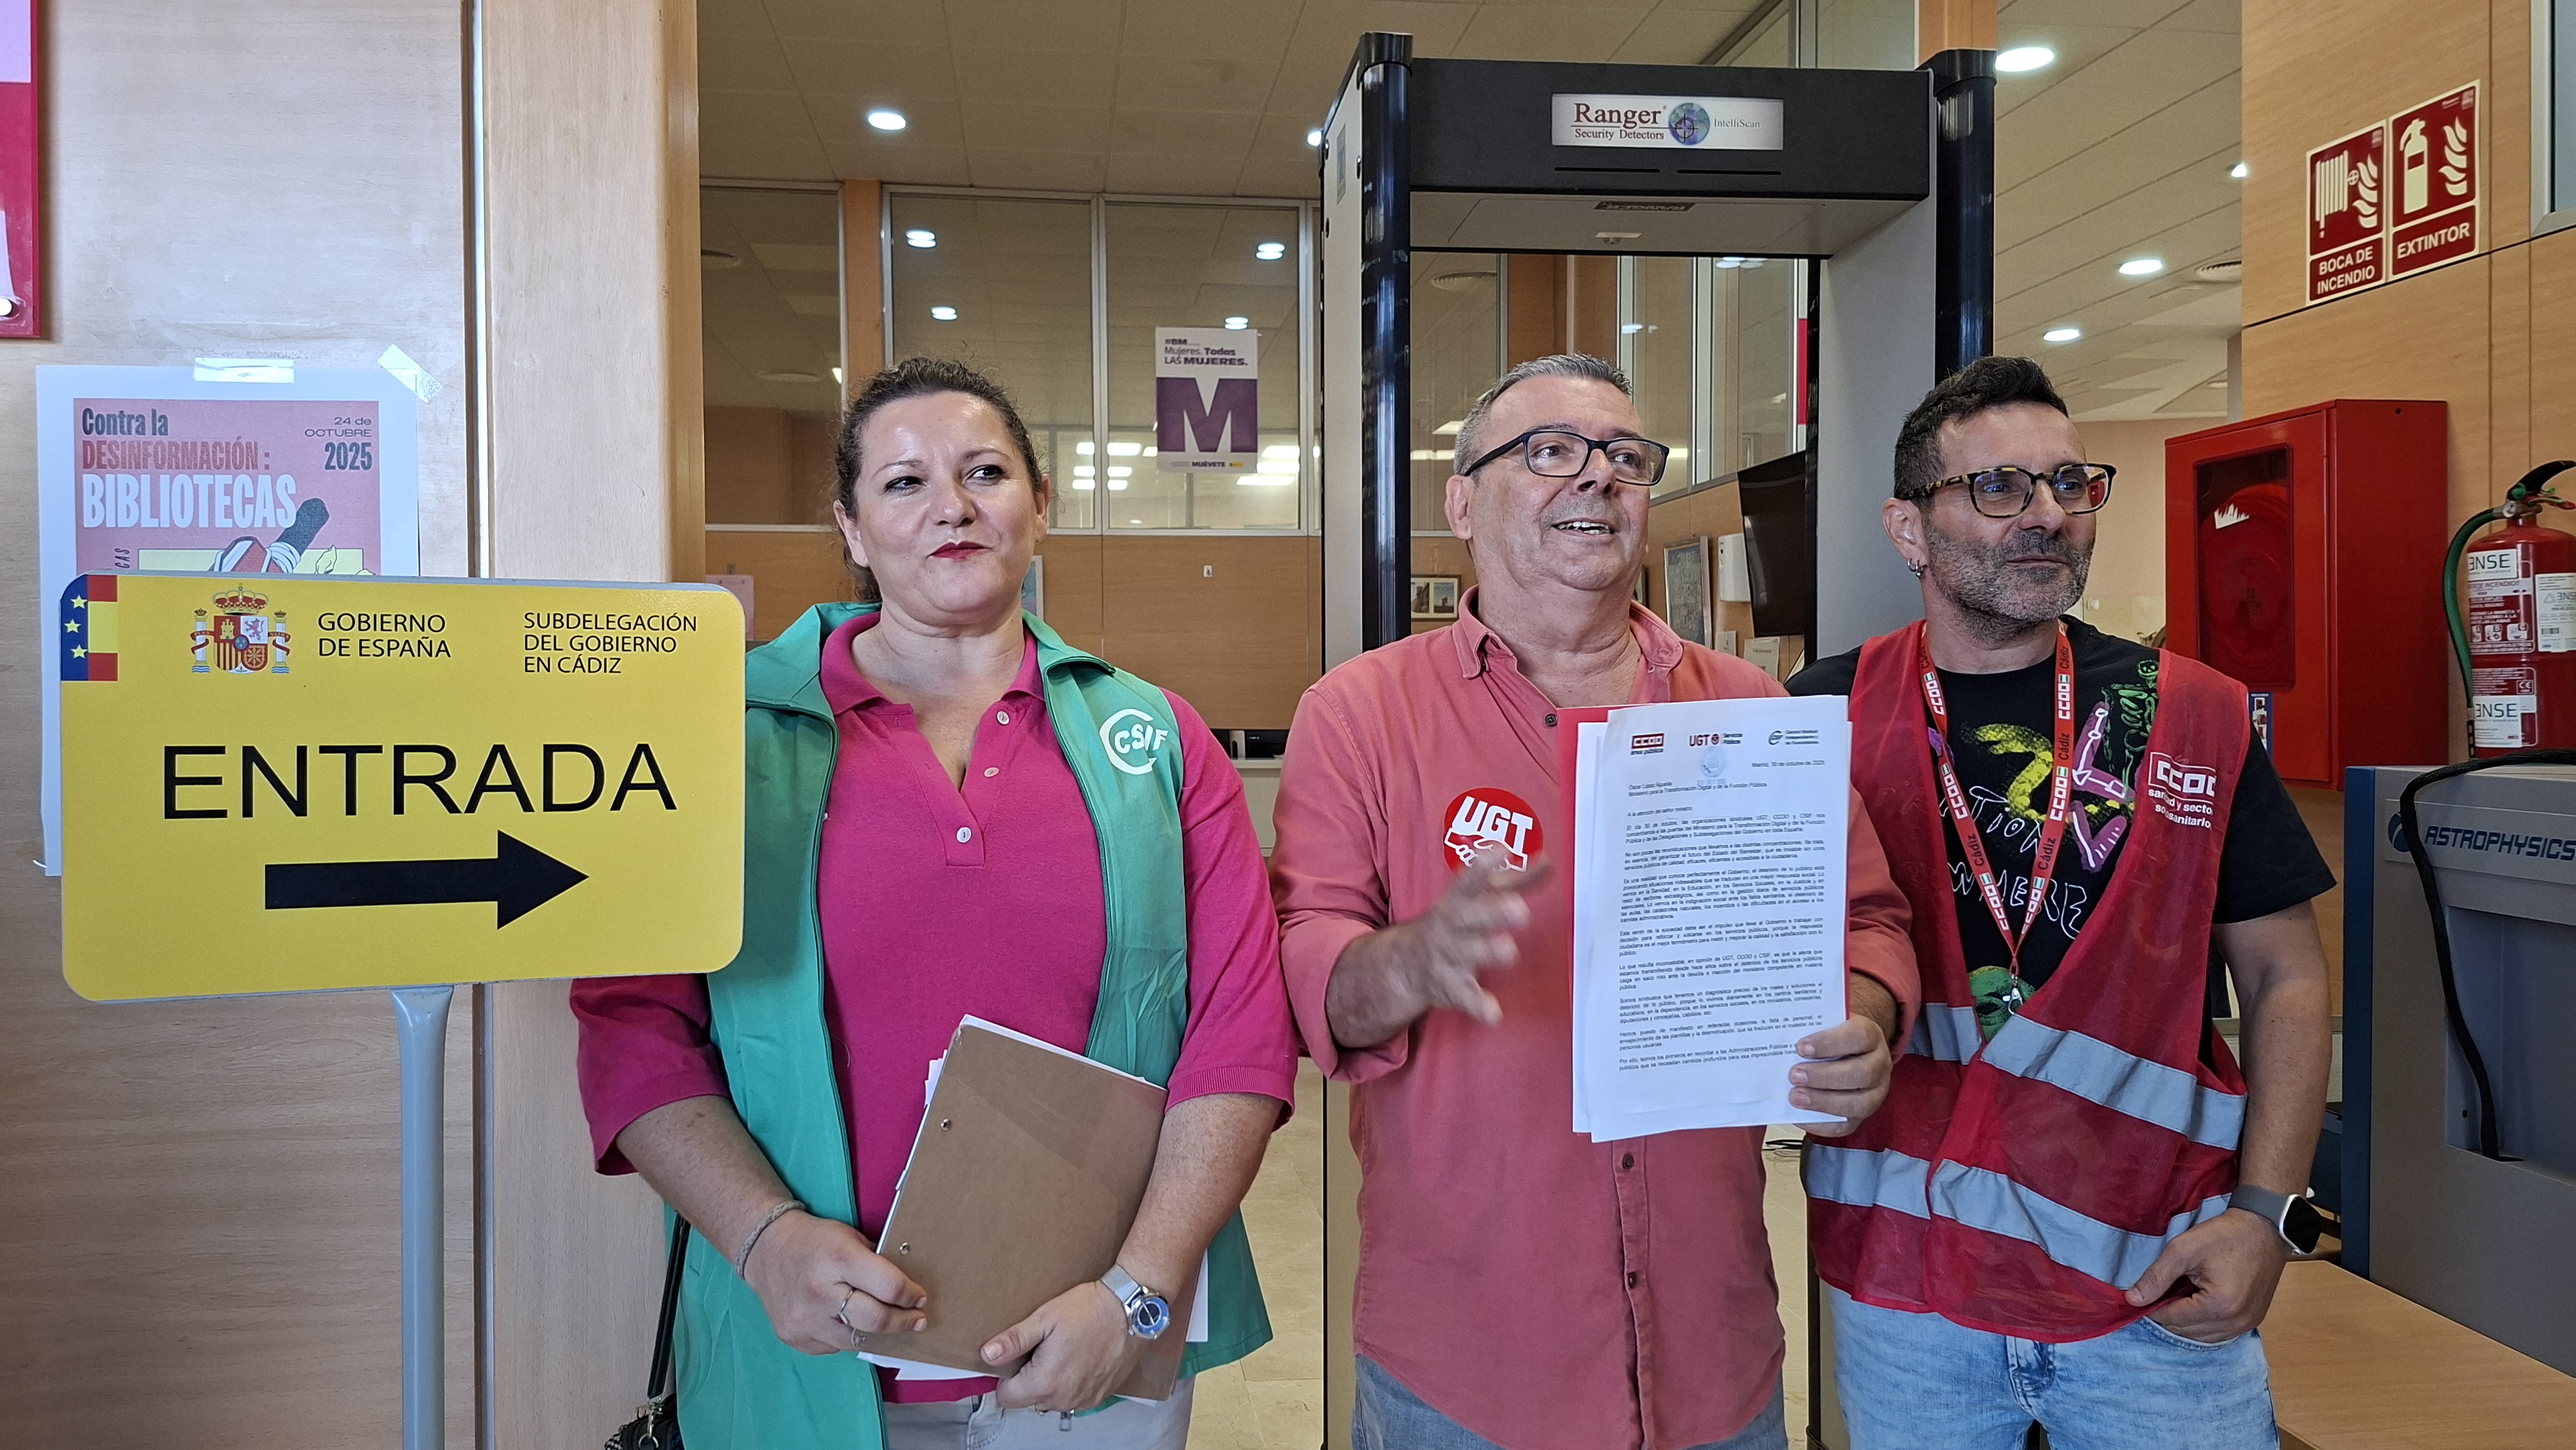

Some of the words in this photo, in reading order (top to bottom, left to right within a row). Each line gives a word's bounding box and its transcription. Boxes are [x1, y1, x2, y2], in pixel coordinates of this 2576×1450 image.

[1575, 129, 1614, 141] Security
[1619, 129, 1664, 140] Detectors
[1714, 118, 1761, 128] IntelliScan
[2397, 222, 2470, 259] EXTINTOR
[2319, 252, 2353, 276] BOCA
[2355, 246, 2374, 264] DE
[2317, 266, 2375, 295] INCENDIO
[1184, 357, 1249, 366] MUJERES.
[82, 408, 146, 436] Contra
[151, 409, 169, 436] la
[334, 417, 352, 426] 24
[355, 417, 372, 426] de
[1157, 377, 1258, 453] M
[305, 429, 372, 437] OCTUBRE
[324, 442, 372, 470] 2025
[83, 474, 297, 528] BIBLIOTECAS
[318, 612, 446, 633] GOBIERNO
[524, 612, 696, 632] SUBDELEGACIÓN
[319, 638, 351, 657] DE
[358, 636, 451, 657] ESPAÑA
[524, 634, 564, 651] DEL
[569, 635, 677, 653] GOBIERNO
[2060, 646, 2070, 669] Cádiz
[524, 656, 551, 673] EN
[557, 654, 621, 673] CÁDIZ
[2058, 683, 2070, 720] CCOO
[1114, 723, 1169, 753] CSIF
[1689, 734, 1710, 746] UGT
[2058, 733, 2070, 760] Cádiz
[164, 743, 677, 820] ENTRADA
[1944, 773, 1969, 820] CCOO
[2049, 777, 2068, 821] CCOO
[1452, 795, 1533, 854] UGT
[1967, 833, 1985, 867] Cádiz
[2038, 837, 2056, 871] Cádiz
[2424, 825, 2576, 862] ASTROPHYSICS
